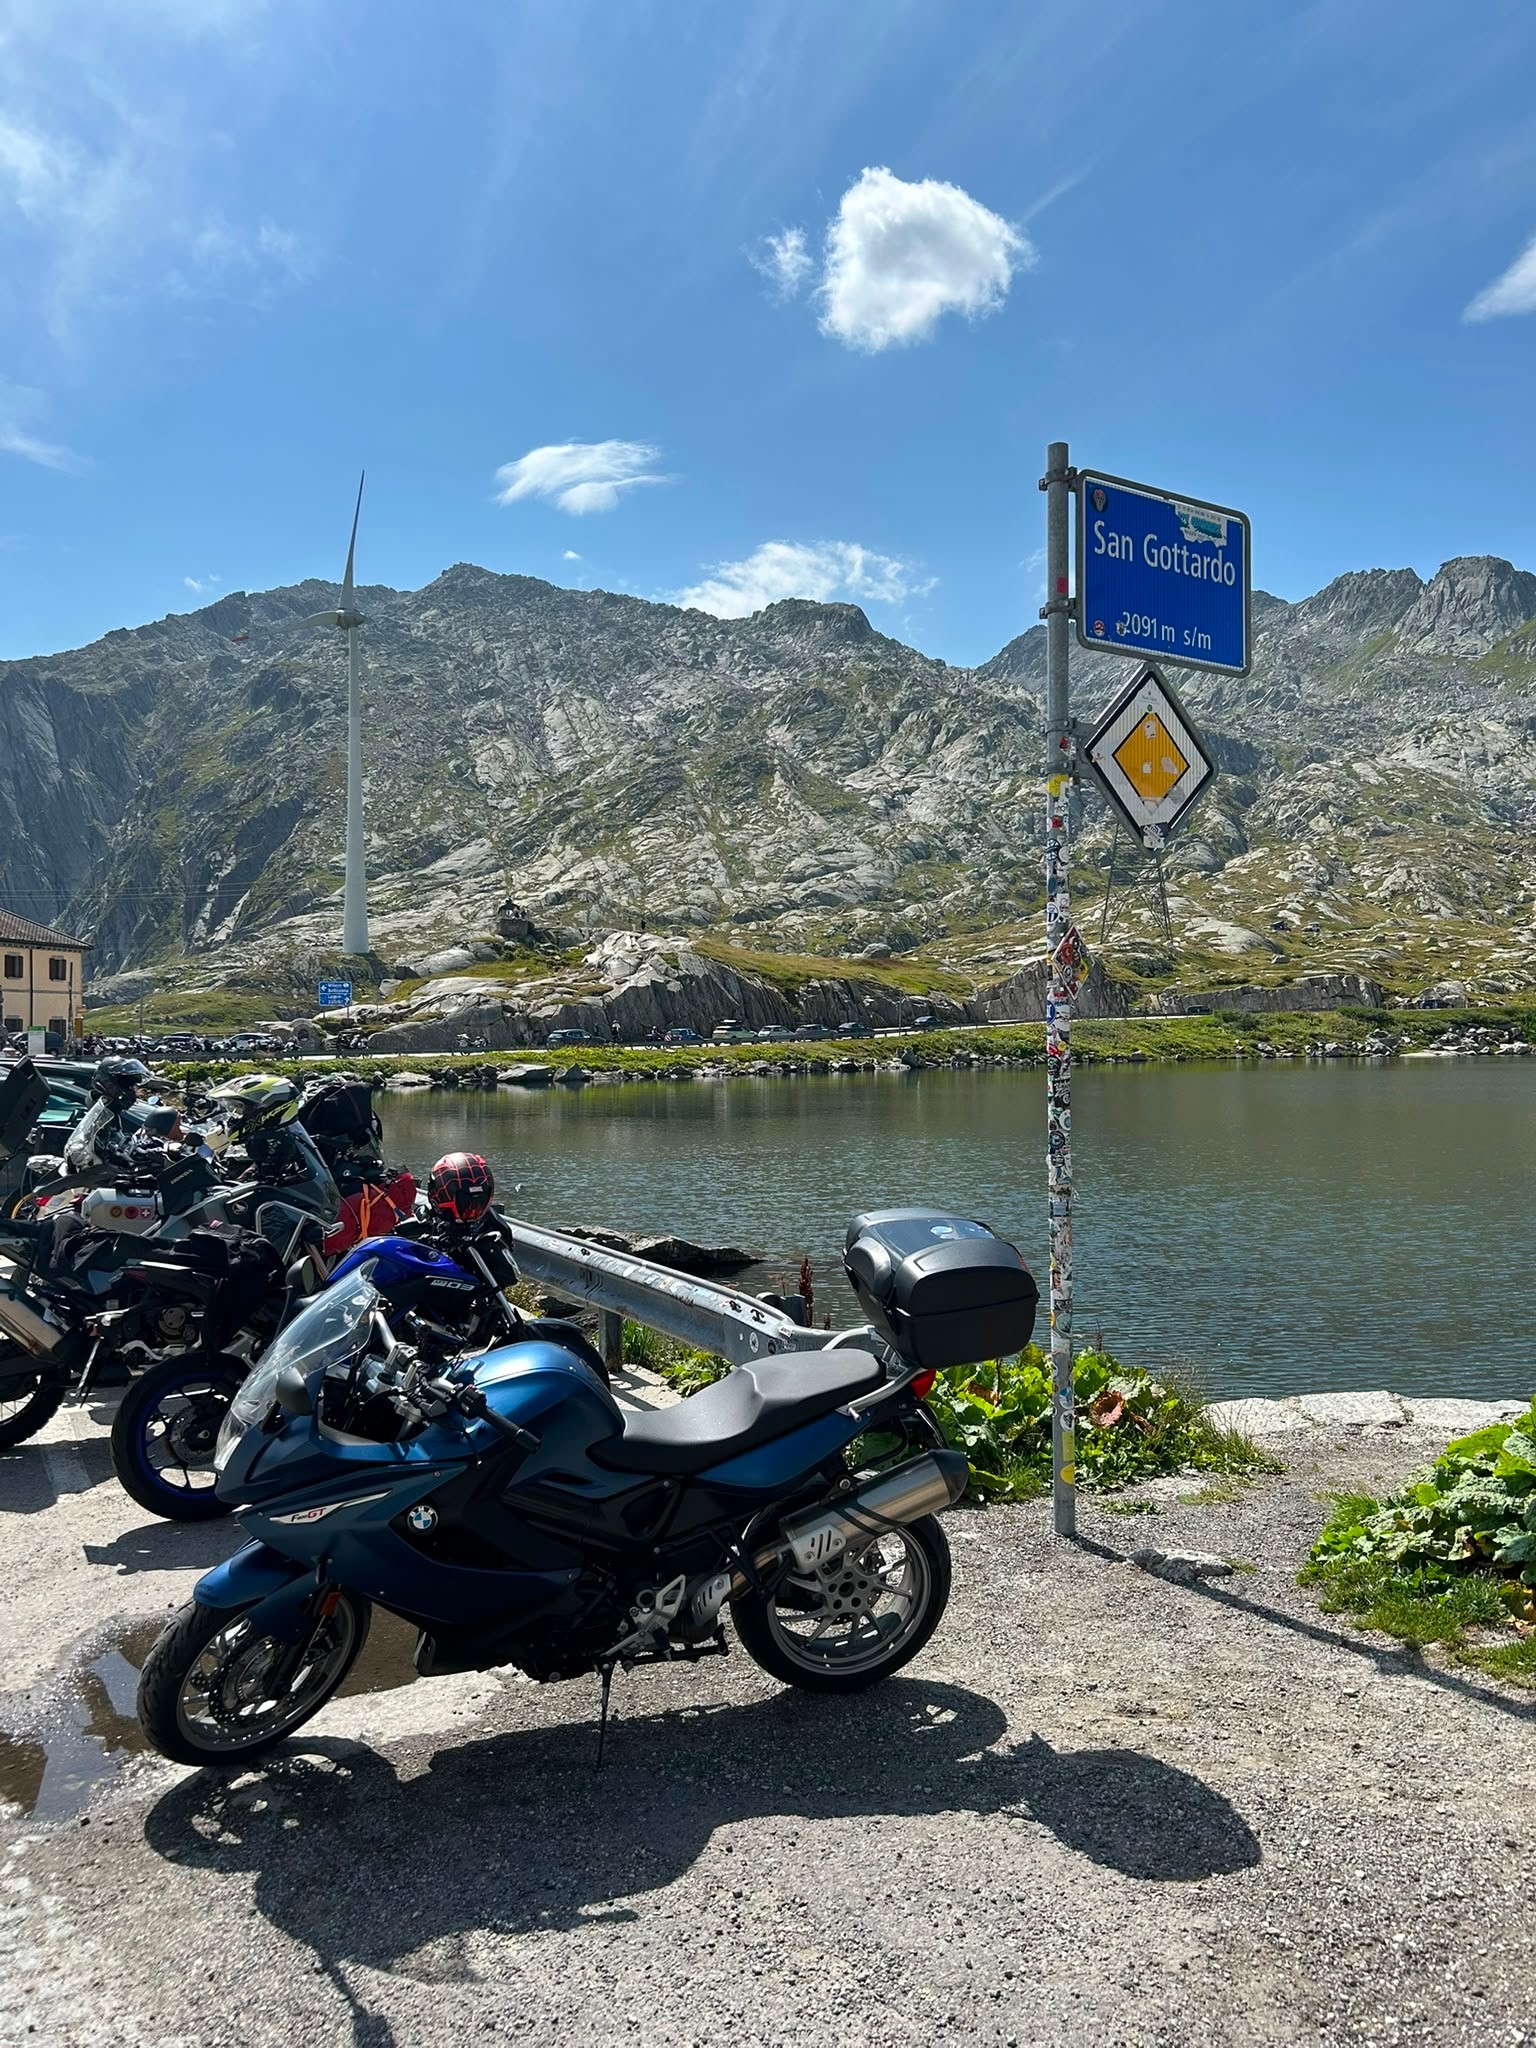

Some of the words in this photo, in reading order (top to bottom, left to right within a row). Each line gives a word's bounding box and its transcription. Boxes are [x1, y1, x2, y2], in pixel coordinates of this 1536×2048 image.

[1094, 520, 1133, 562] San
[1143, 533, 1236, 586] Gottardo
[1183, 626, 1211, 650] s/m
